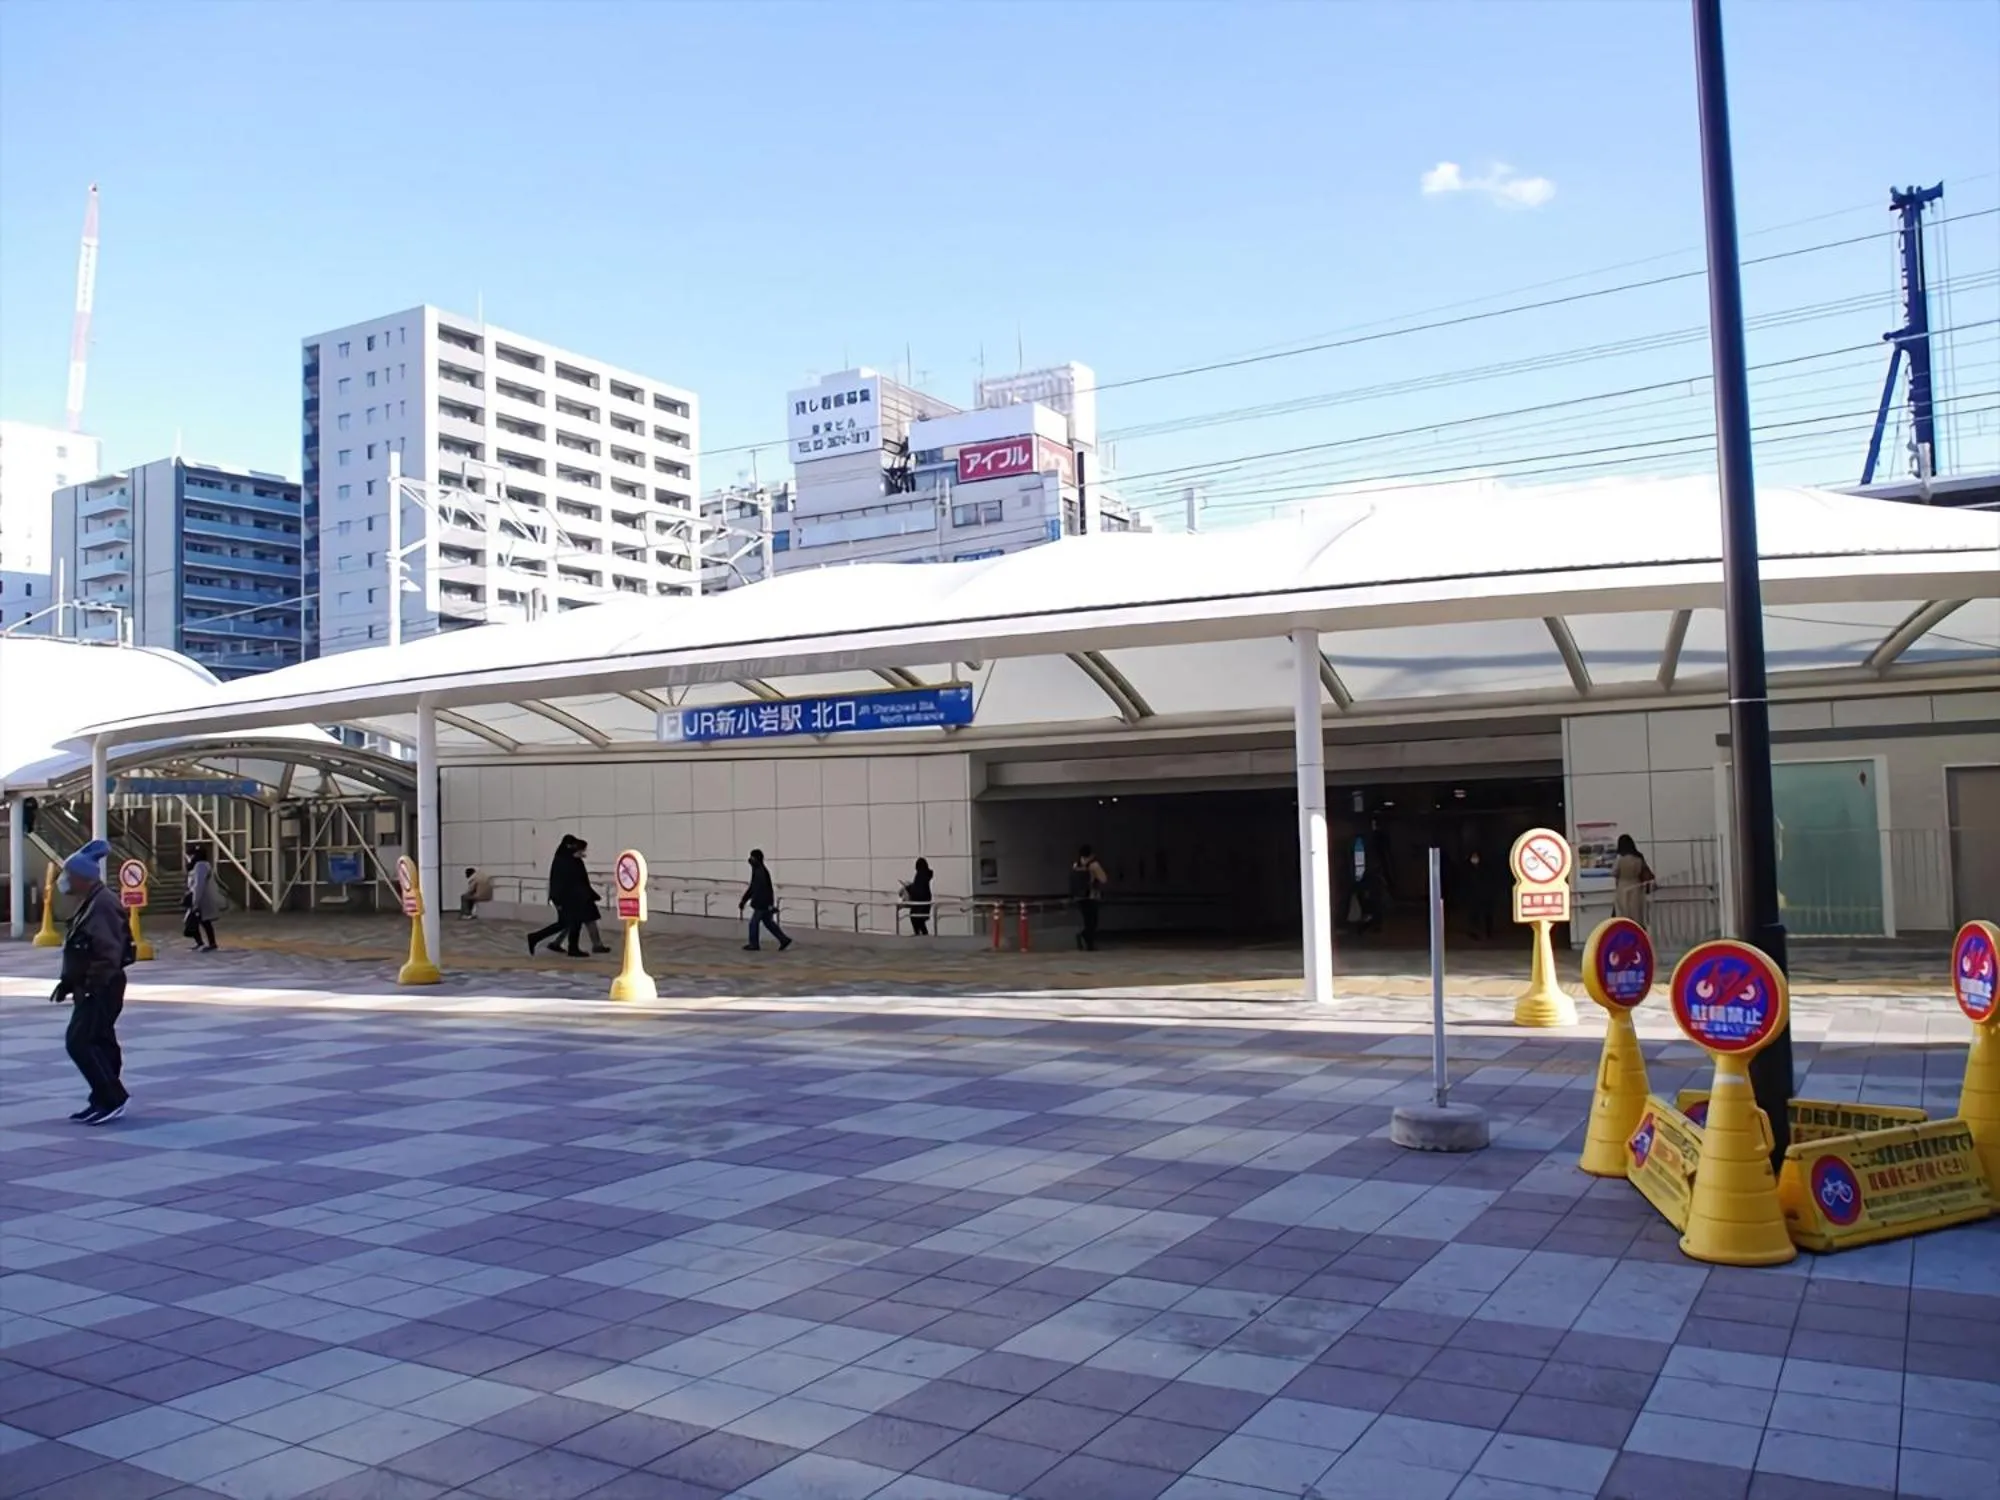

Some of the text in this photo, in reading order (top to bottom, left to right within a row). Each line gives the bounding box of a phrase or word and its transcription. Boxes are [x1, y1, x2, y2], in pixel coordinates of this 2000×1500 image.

[964, 445, 1030, 474] アイフル
[685, 700, 856, 736] JR新小岩駅 北口
